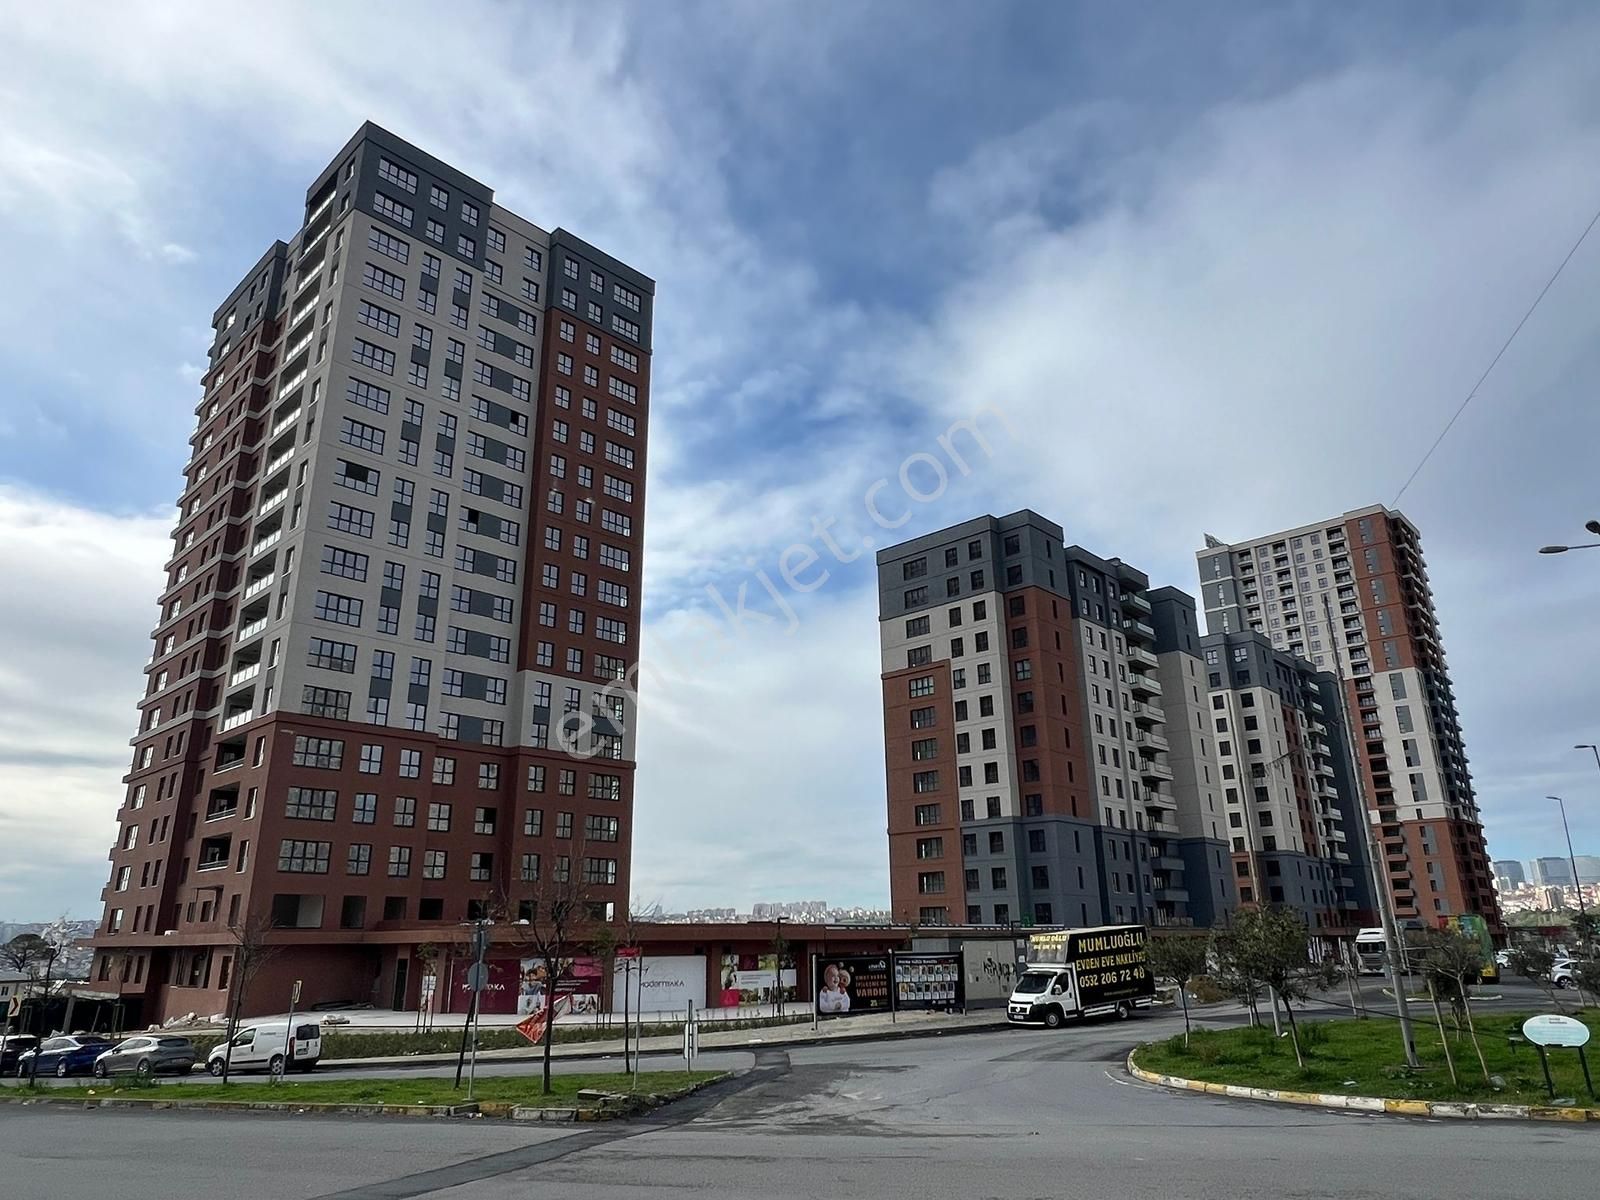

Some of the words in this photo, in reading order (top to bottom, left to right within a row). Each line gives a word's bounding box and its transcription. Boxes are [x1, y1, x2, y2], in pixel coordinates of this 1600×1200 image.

[1078, 931, 1144, 953] MUMLUOĞLU
[1076, 958, 1100, 971] EVDEN
[1101, 956, 1115, 968] EVE
[1080, 974, 1099, 988] 0532
[1101, 972, 1117, 985] 206
[1120, 969, 1131, 982] 72
[1133, 967, 1145, 980] 48
